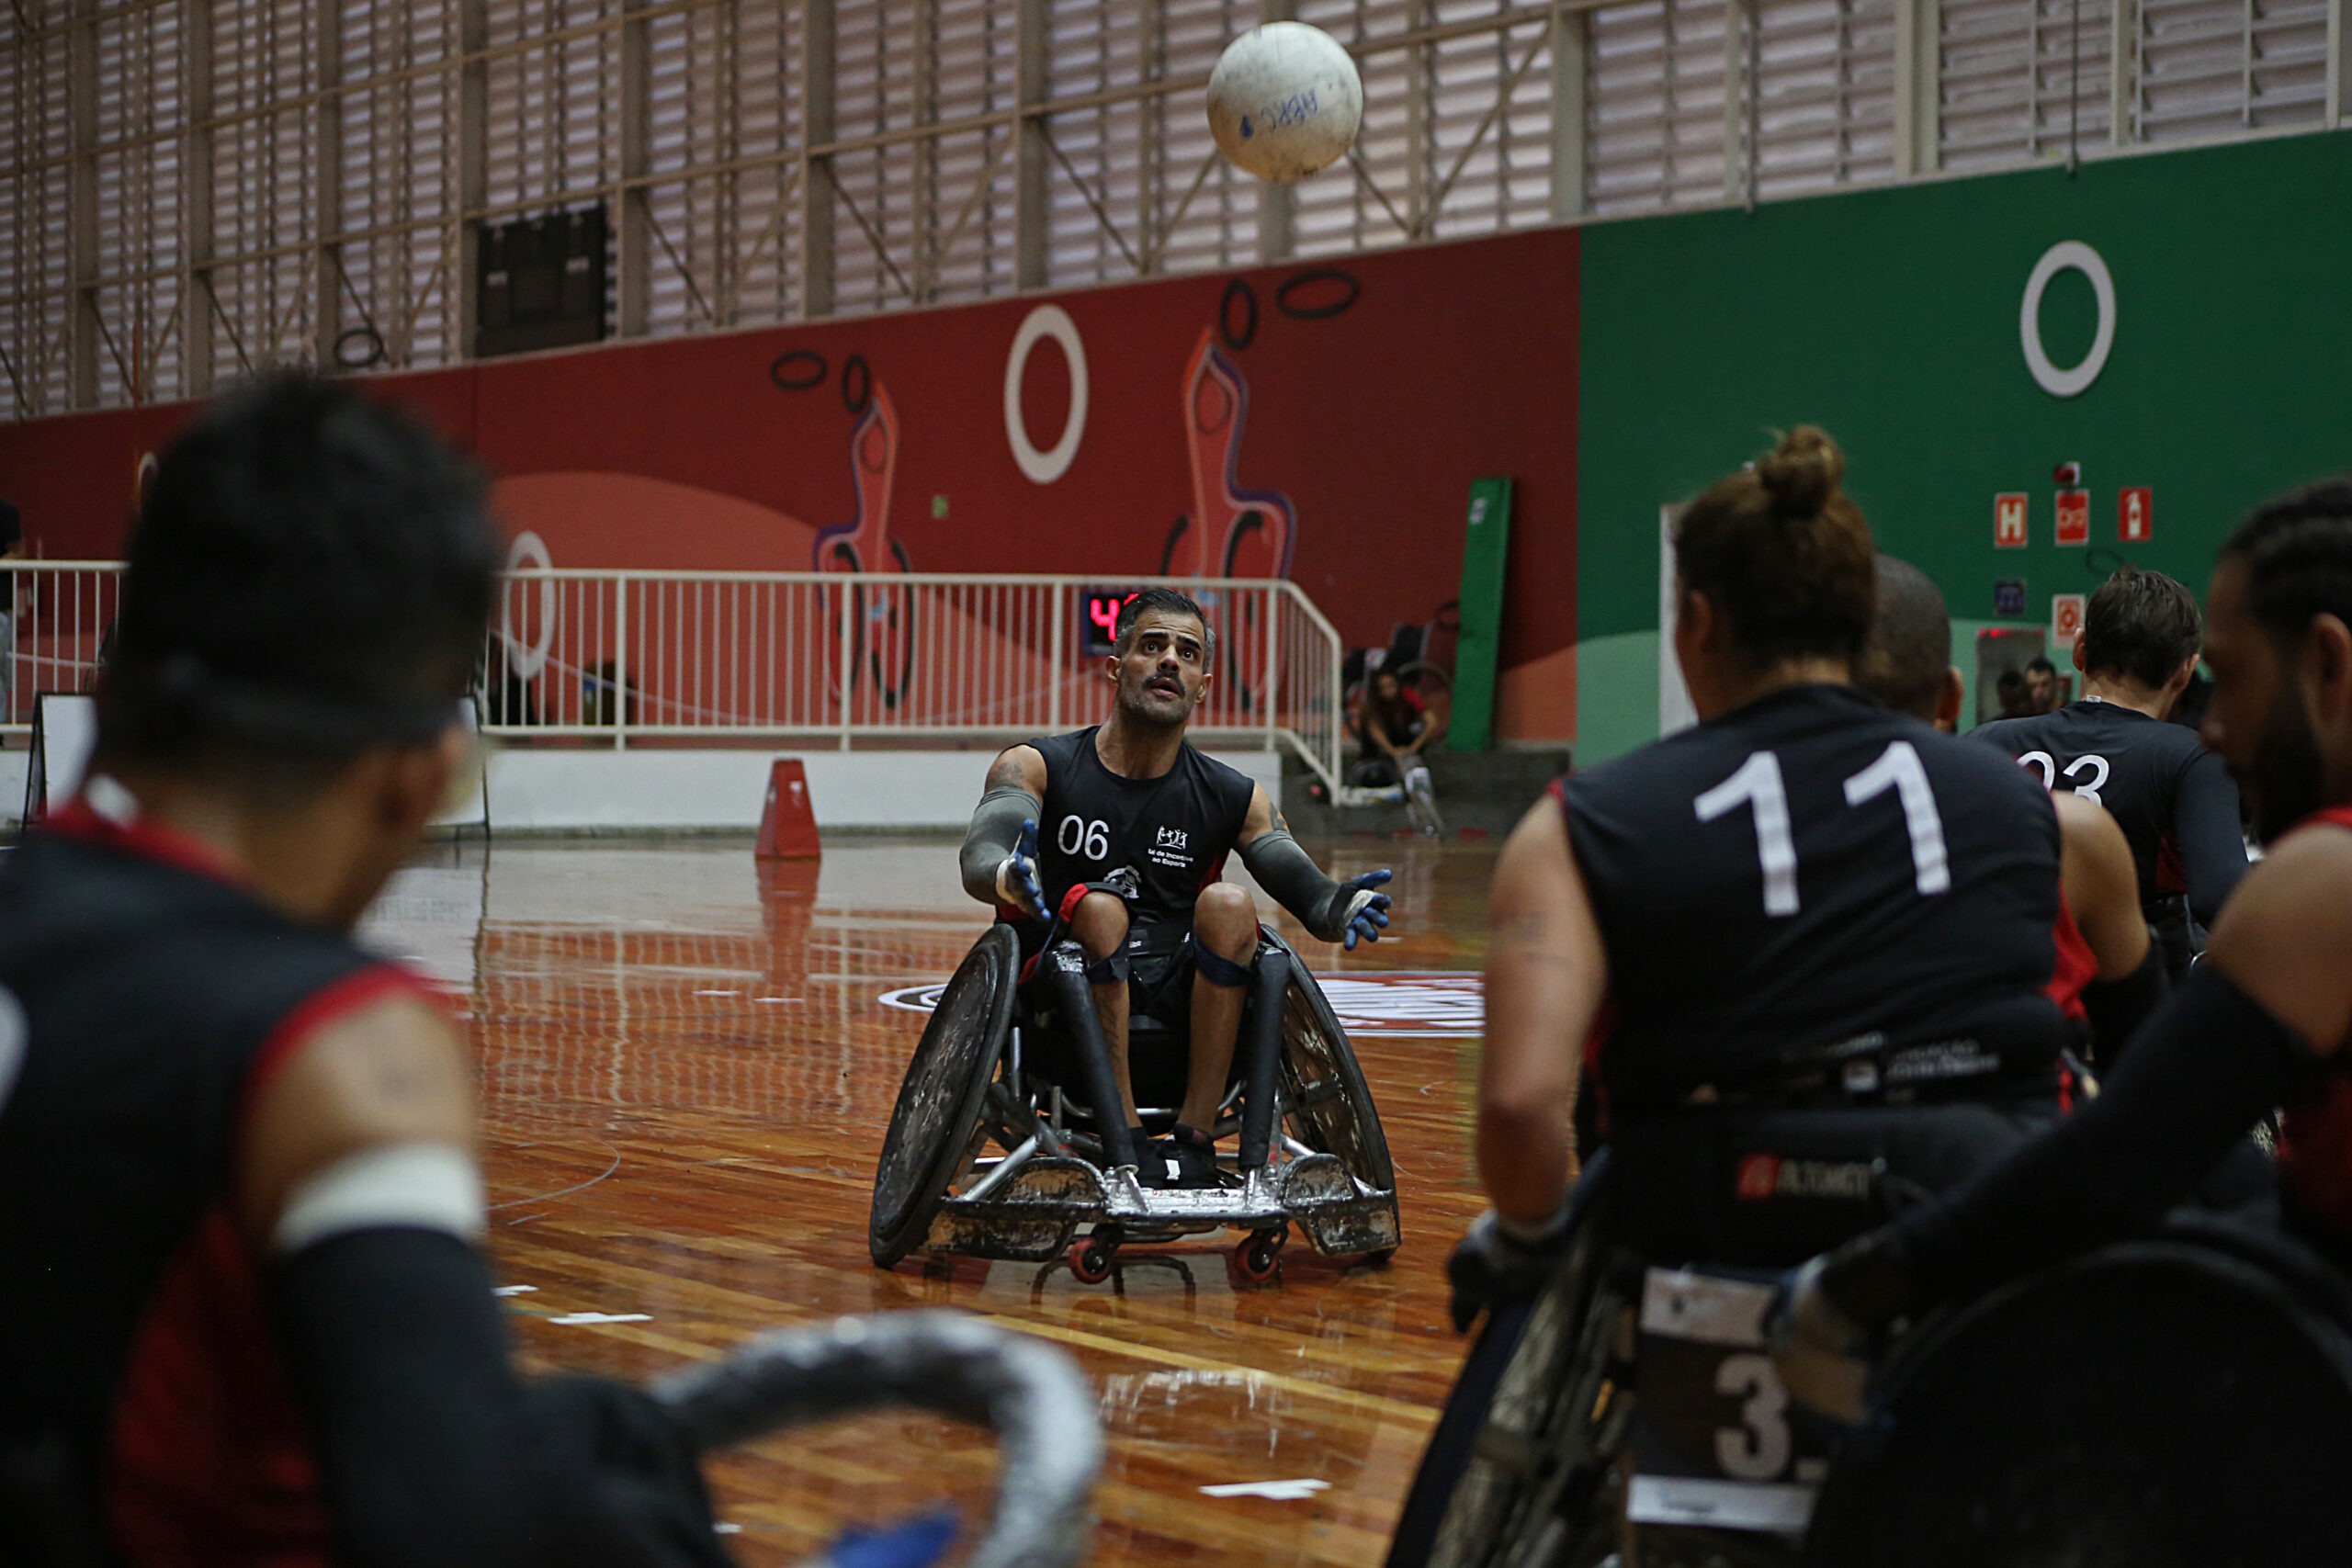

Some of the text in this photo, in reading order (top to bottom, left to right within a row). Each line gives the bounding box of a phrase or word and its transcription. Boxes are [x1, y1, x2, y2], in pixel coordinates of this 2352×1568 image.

[2000, 502, 2022, 538] H
[1057, 814, 1110, 861] 06
[1693, 740, 1951, 917] 11
